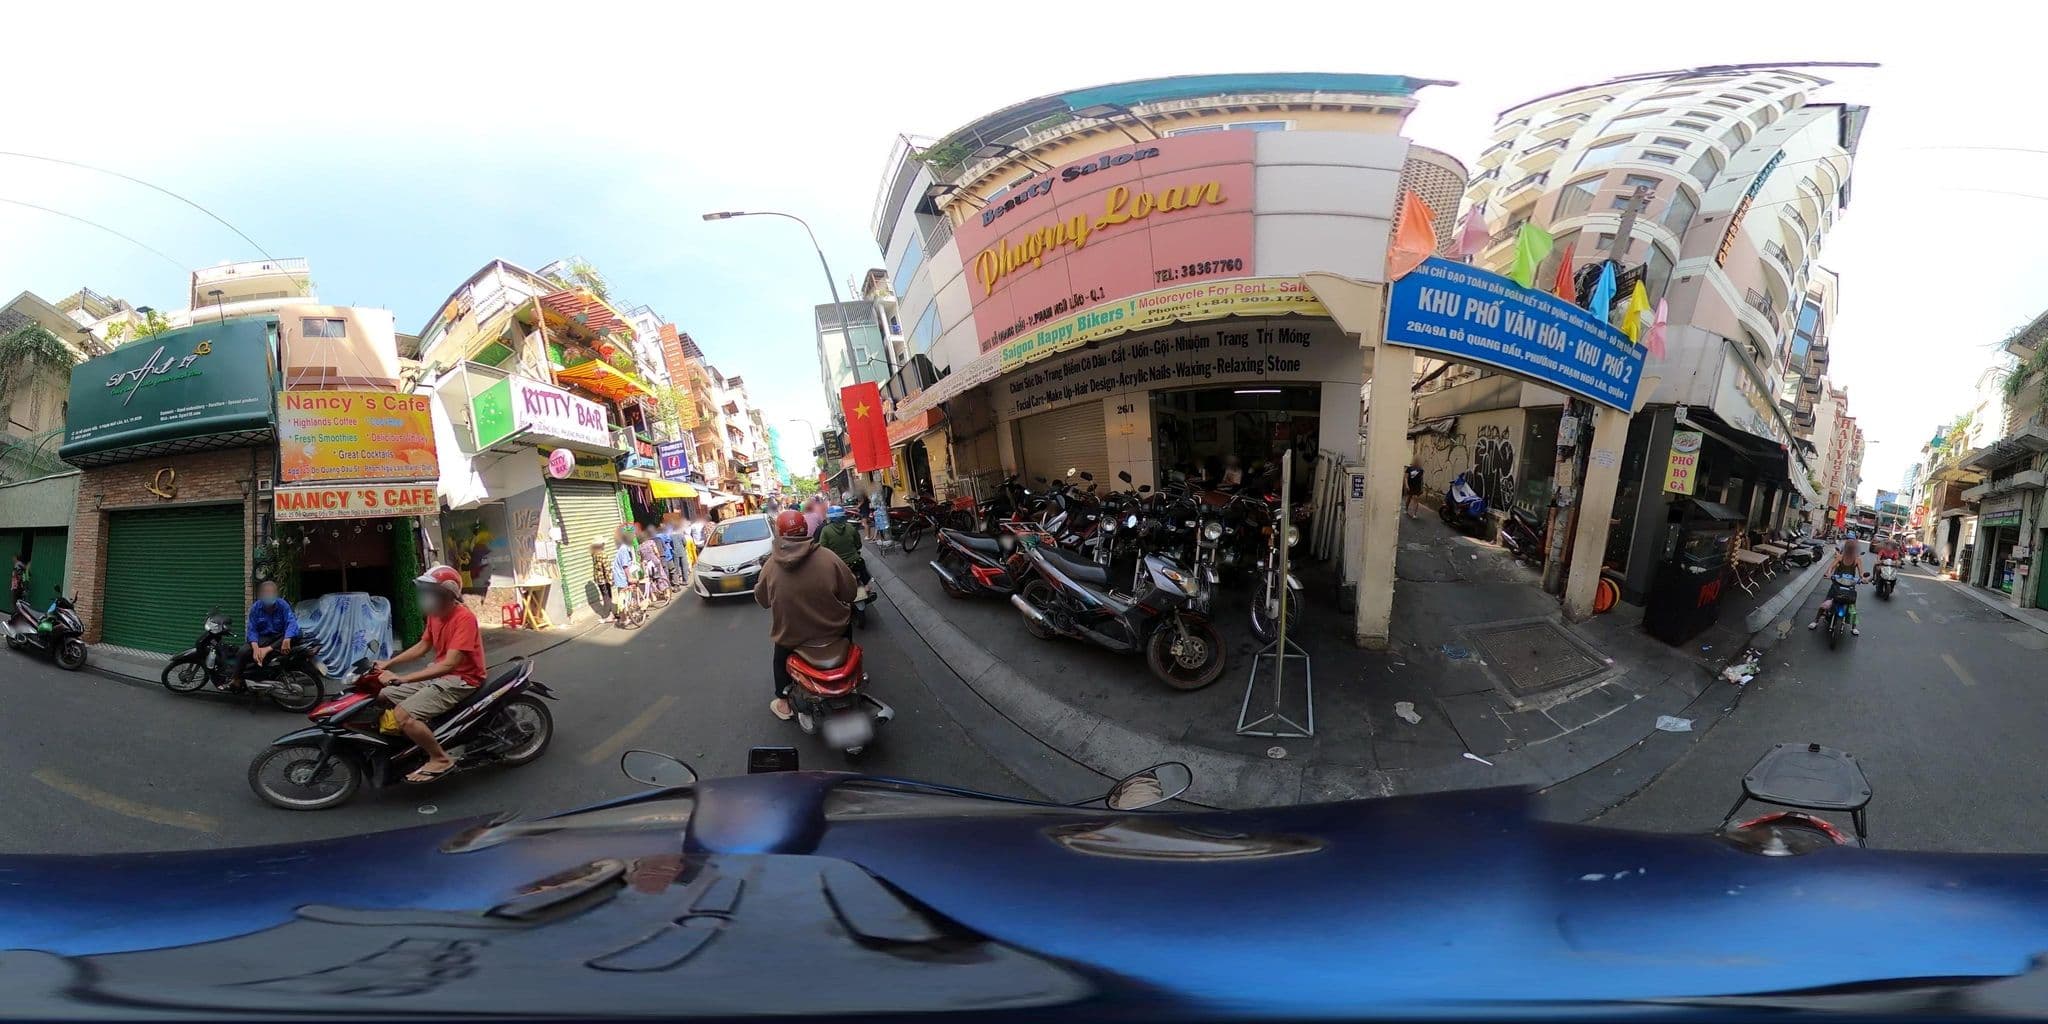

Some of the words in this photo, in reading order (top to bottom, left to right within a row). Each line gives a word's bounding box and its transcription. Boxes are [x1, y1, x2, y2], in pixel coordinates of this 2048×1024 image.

[981, 176, 1055, 227] Beauty
[1061, 147, 1160, 182] Salon
[974, 213, 1093, 297] Phượng
[1094, 180, 1228, 230] Loan
[1430, 265, 1448, 279] CHỈ
[1447, 271, 1466, 284] ĐẠO
[1147, 303, 1191, 316] Phone:
[1196, 297, 1235, 308] (+84)
[1002, 339, 1034, 362] Saigon
[1036, 323, 1073, 346] Happy
[1077, 307, 1124, 332] Bikers
[1138, 287, 1205, 310] Motorcycle
[1208, 285, 1230, 299] For
[1234, 283, 1266, 294] Rent
[1153, 338, 1170, 357] Gội
[1175, 335, 1210, 353] Nhuộm
[1216, 330, 1249, 348] Trang
[1256, 327, 1273, 345] Trí
[1278, 327, 1312, 347] Móng
[1406, 320, 1447, 338] 26/49A
[1448, 327, 1465, 341] ĐỖ
[1467, 334, 1501, 351] QUANG
[1418, 286, 1461, 317] KHU
[1464, 298, 1505, 329] PHỐ
[1504, 308, 1537, 341] VĂN
[1536, 322, 1567, 353] HÓA
[1574, 339, 1601, 367] KHU
[1601, 353, 1628, 380] PHỐ
[1623, 365, 1633, 384] 2
[1090, 375, 1116, 393] Design
[1118, 368, 1149, 387] Acrylic
[1149, 363, 1171, 381] Nails
[1175, 361, 1211, 378] Waxing
[1216, 356, 1264, 375] Relaxing
[1267, 355, 1300, 372] Stone
[286, 395, 352, 412] Nancy
[360, 395, 376, 409] 's
[384, 396, 425, 412] Cafe
[521, 386, 571, 419] KITTY
[575, 403, 604, 431] BAR
[1117, 403, 1134, 415] 26/1
[293, 418, 331, 429] Highlands
[333, 418, 357, 426] Coffee
[294, 434, 316, 443] Fresh
[319, 433, 358, 443] Smoothies
[338, 450, 359, 460] Great
[360, 449, 394, 459] Cocktails
[1671, 454, 1695, 465] PHỞ
[665, 467, 686, 476] Center
[275, 491, 351, 510] NANCY
[357, 490, 378, 507] 'S
[383, 489, 434, 507] CAFE
